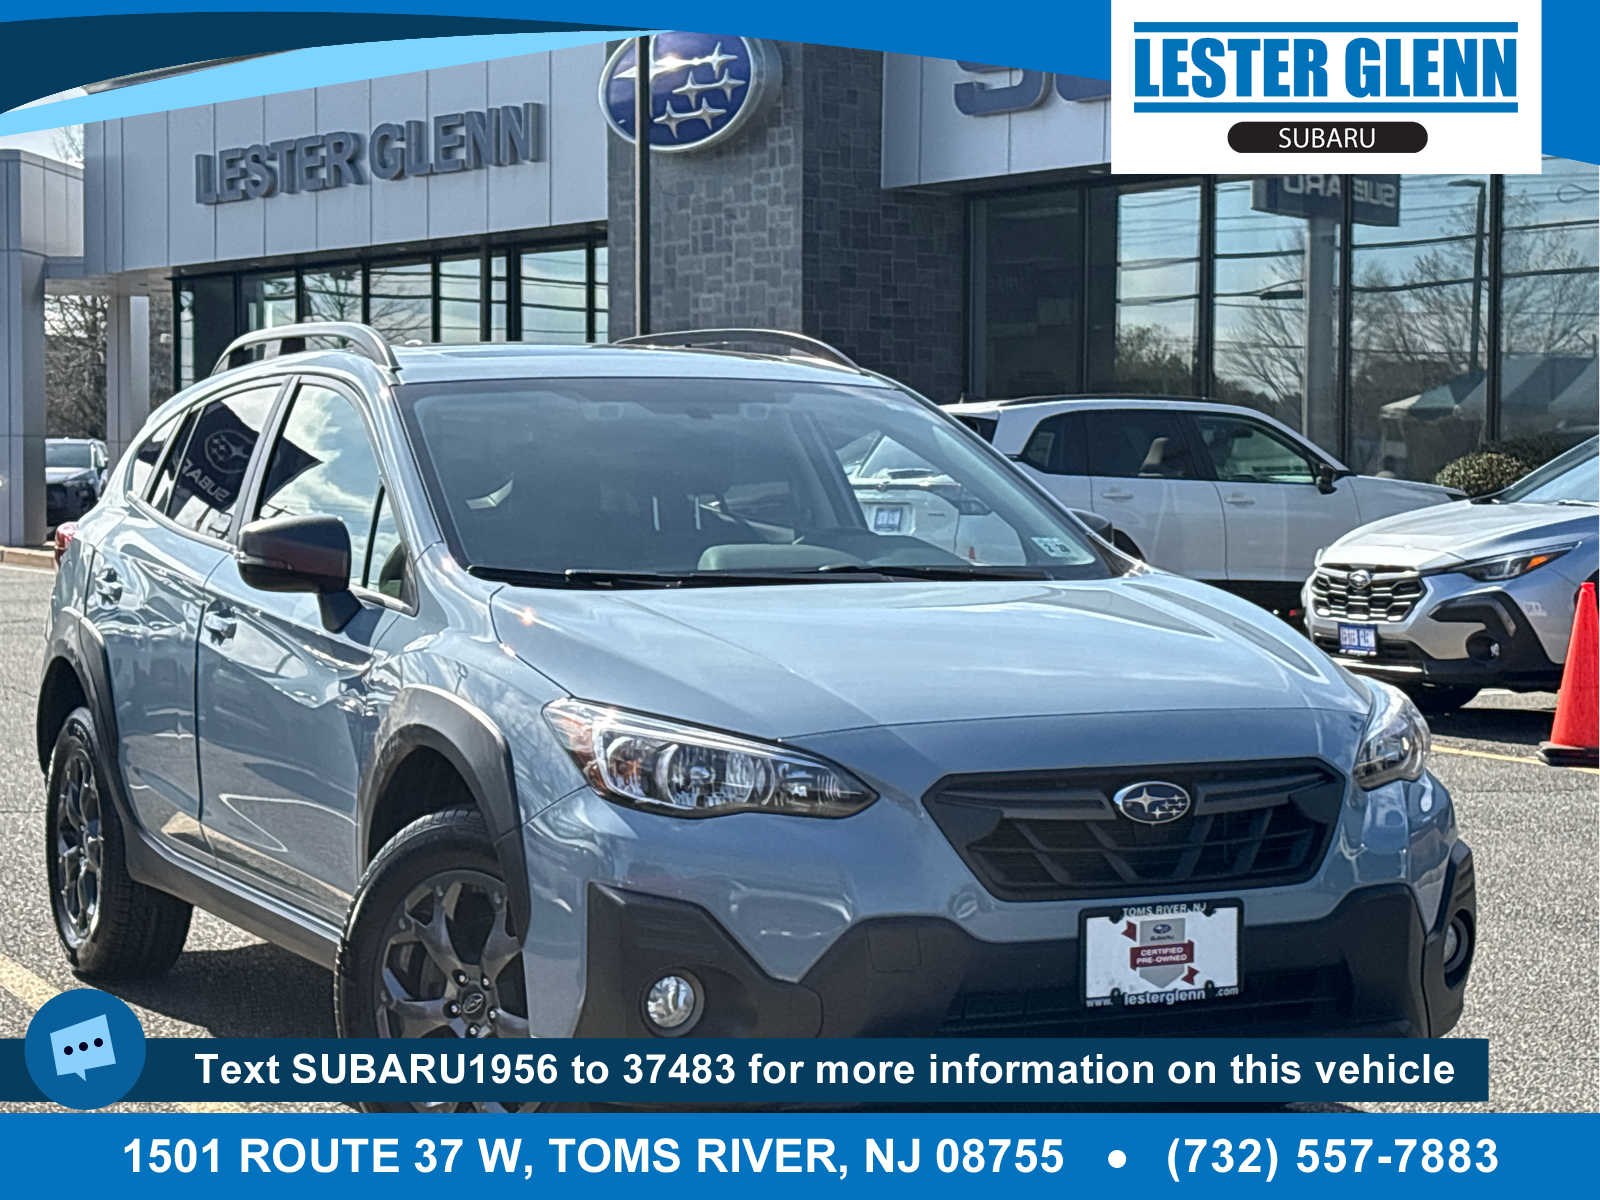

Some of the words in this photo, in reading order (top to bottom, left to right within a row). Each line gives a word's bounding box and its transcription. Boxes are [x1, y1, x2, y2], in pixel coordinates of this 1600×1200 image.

[195, 131, 368, 205] LESTER
[369, 102, 547, 181] GLENN
[1122, 906, 1153, 918] TOMS
[1192, 902, 1207, 913] NJ
[1136, 953, 1188, 965] PRE-OWNED
[1140, 946, 1184, 957] CERTIFIED
[1123, 988, 1206, 1006] lesterglenn
[1215, 986, 1239, 998] .com
